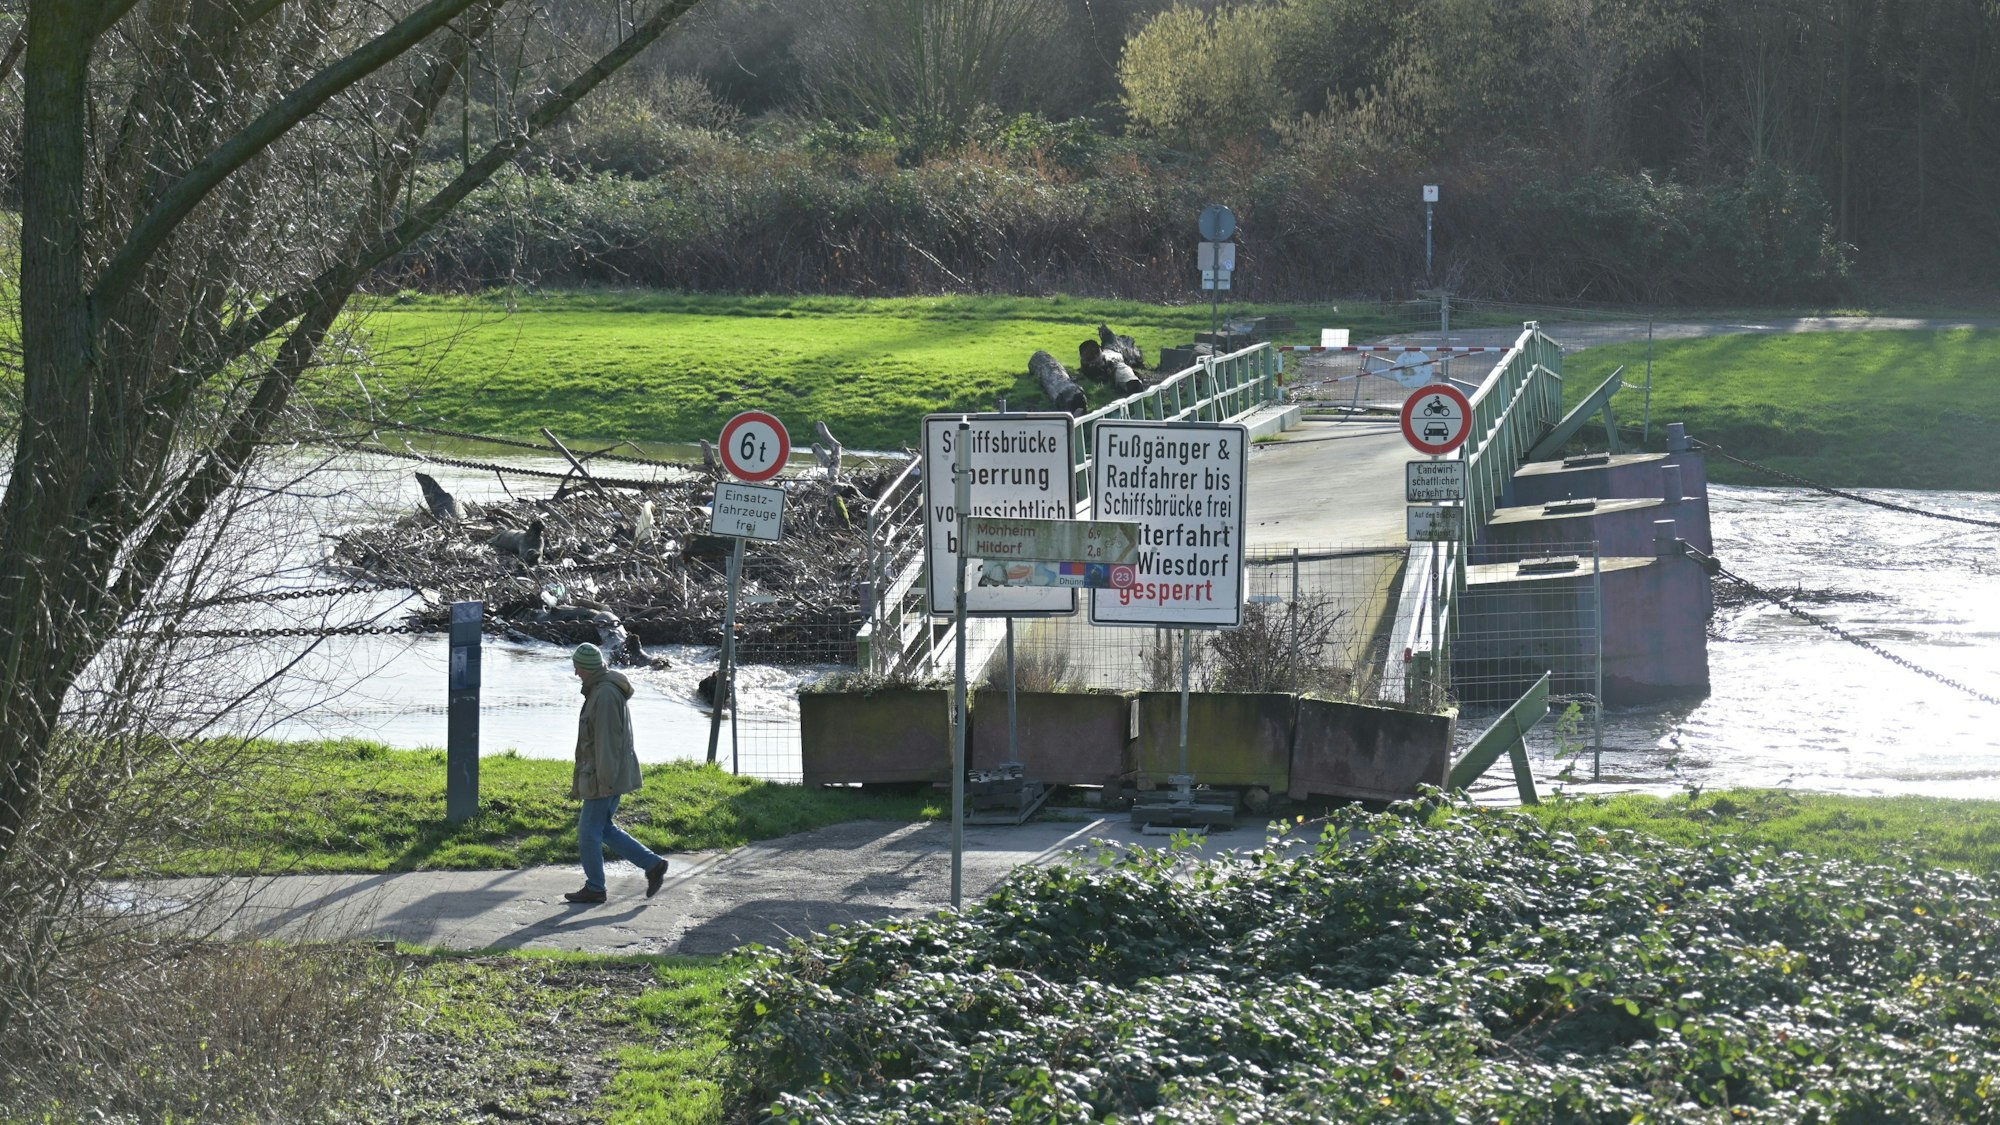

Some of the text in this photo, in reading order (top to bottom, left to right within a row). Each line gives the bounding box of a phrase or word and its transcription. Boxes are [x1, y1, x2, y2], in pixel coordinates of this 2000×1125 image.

[942, 429, 1057, 454] Siffsbrücke
[1108, 433, 1230, 465] Fußgänger &
[1106, 464, 1231, 491] Radfahrer bis
[724, 489, 774, 505] Einsatz-
[1412, 488, 1444, 498] Verkehr
[718, 503, 777, 521] fahrzeuge
[935, 499, 1066, 523] voussichtlich
[1104, 491, 1232, 518] Schiffsbrücke frei
[735, 519, 756, 532] frei
[977, 523, 1036, 538] Monheim
[1138, 522, 1231, 548] iterfahrt
[976, 540, 1023, 555] Hitdorf
[1138, 551, 1229, 577] Wiesdorf
[1115, 572, 1130, 582] 23
